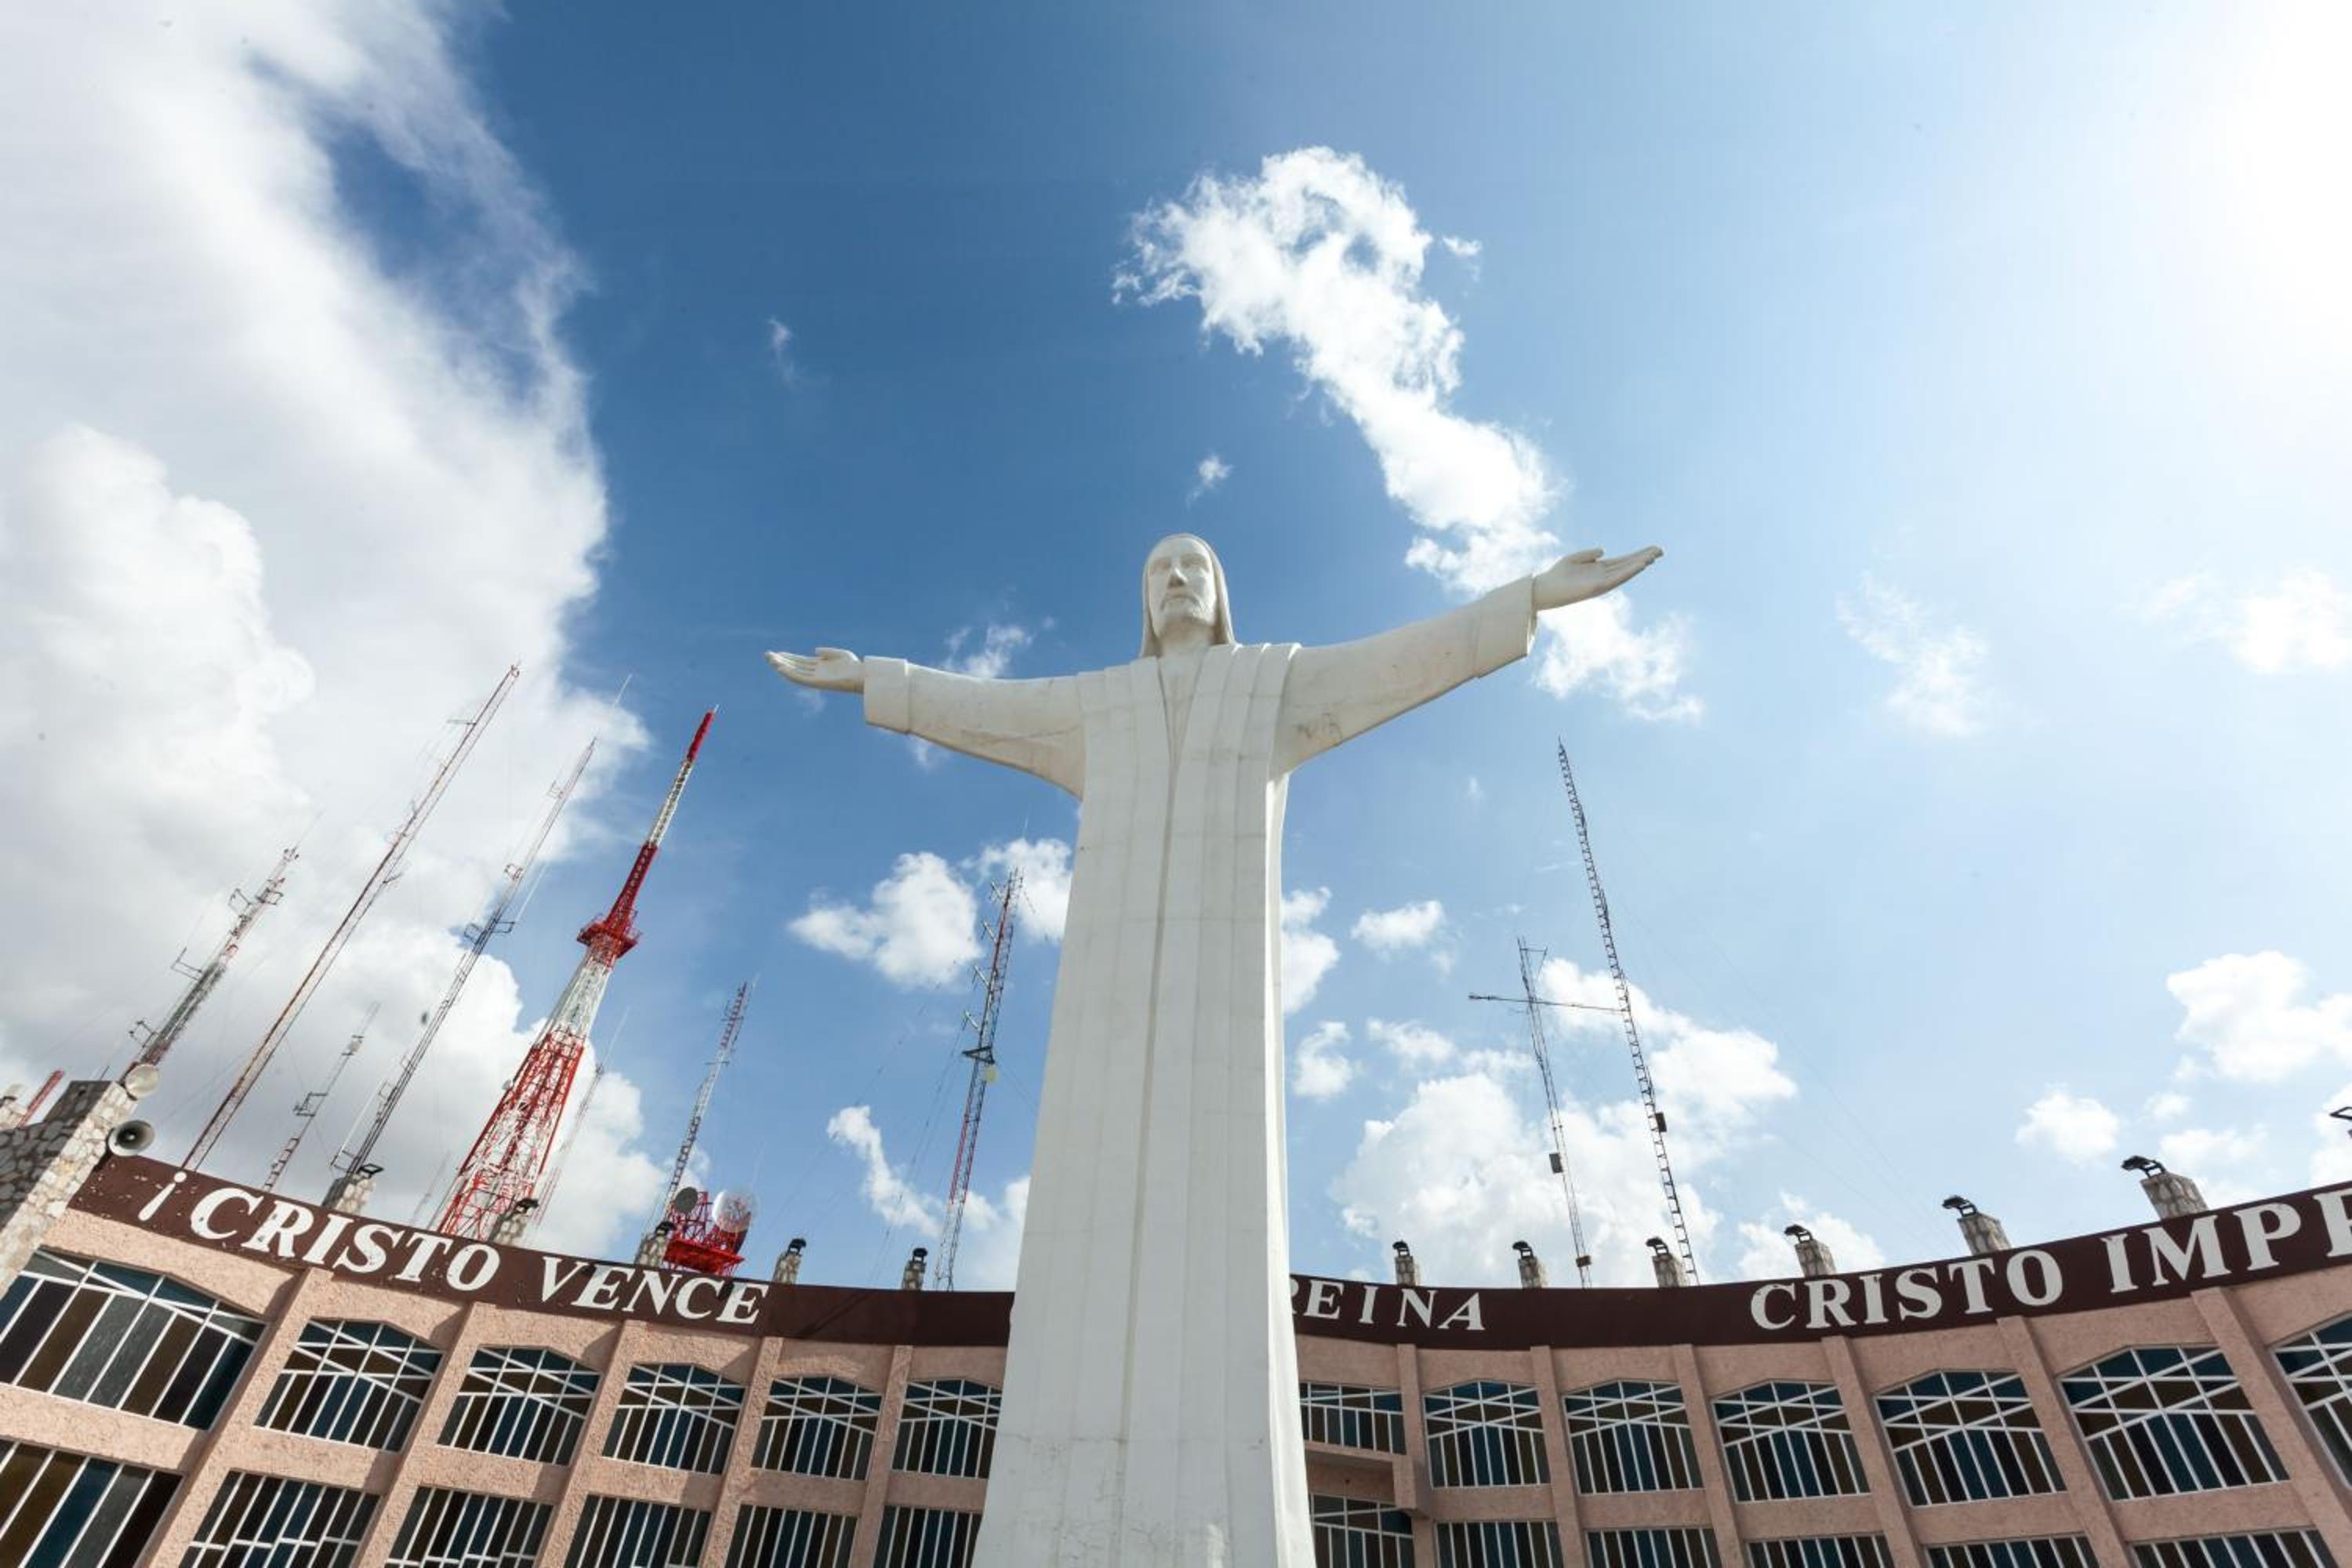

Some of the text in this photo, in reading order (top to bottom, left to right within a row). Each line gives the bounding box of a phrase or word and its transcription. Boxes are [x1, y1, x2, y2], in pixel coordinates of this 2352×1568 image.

[190, 1187, 500, 1291] CRISTO
[538, 1256, 769, 1325] VENCE
[1750, 1250, 2063, 1330] CRISTO
[1290, 1278, 1486, 1330] EINA
